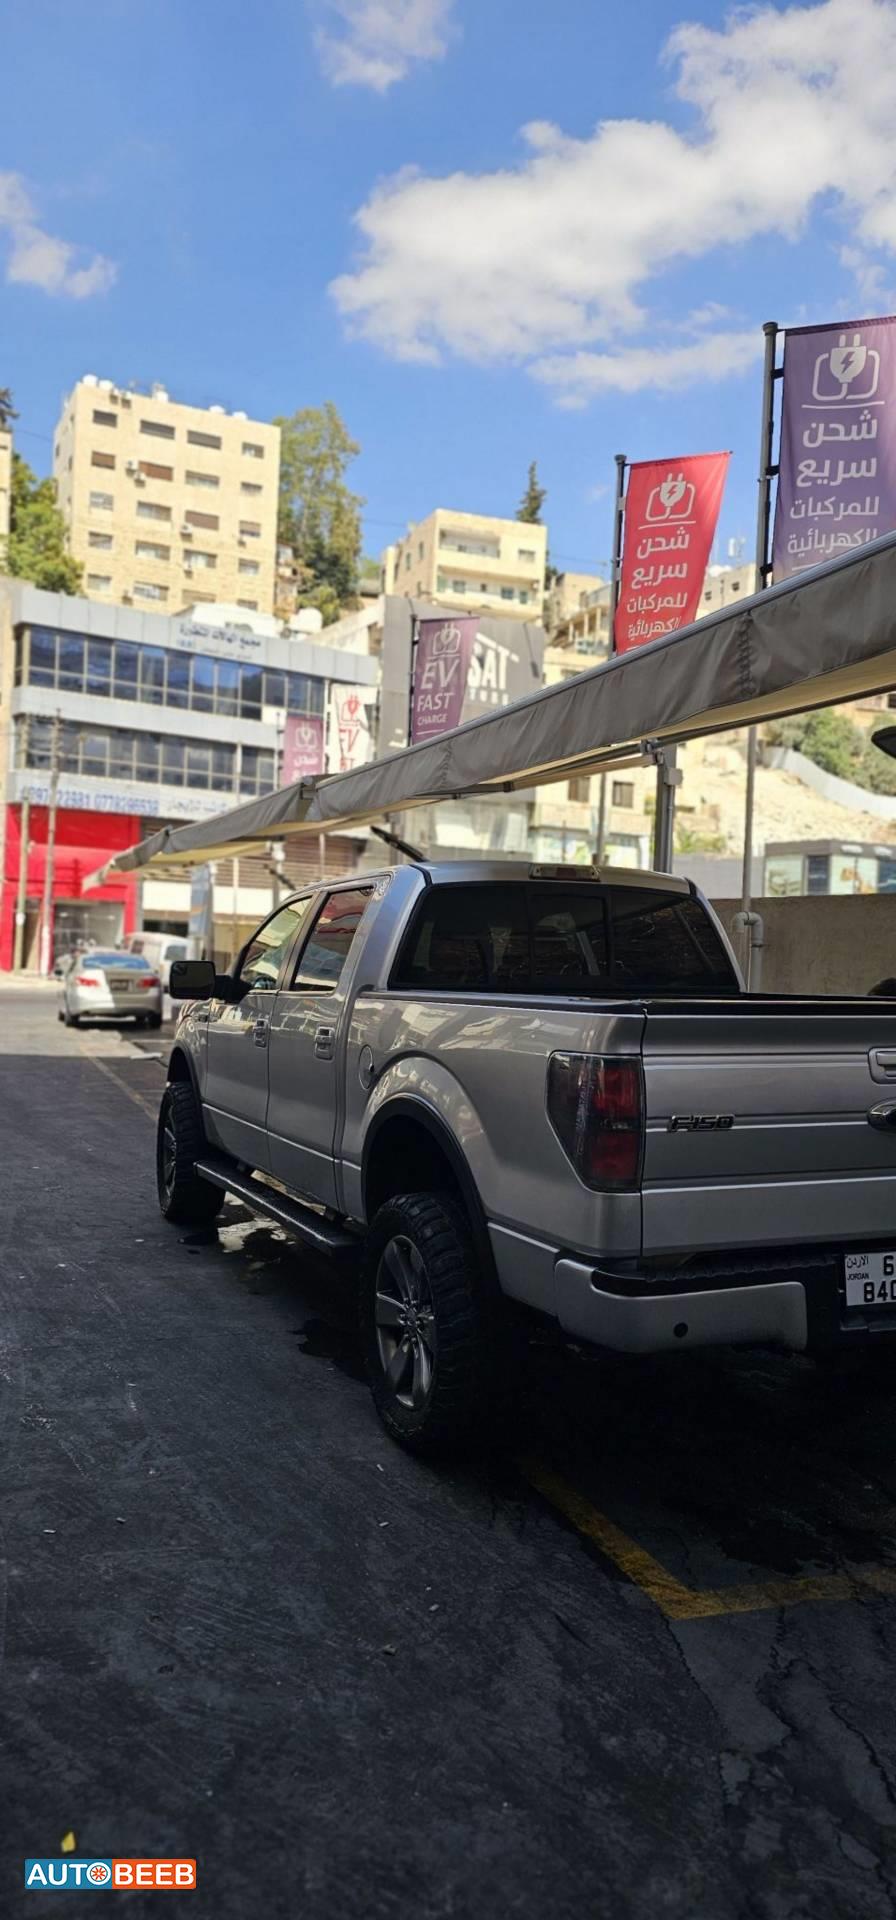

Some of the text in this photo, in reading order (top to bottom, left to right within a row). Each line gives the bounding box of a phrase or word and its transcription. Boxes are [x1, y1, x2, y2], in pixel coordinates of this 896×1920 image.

[803, 409, 877, 447] شحن
[796, 457, 877, 487] سريع
[790, 496, 879, 521] للمركبات
[637, 526, 690, 559] شحن
[631, 562, 688, 589] سريع
[627, 592, 688, 614] للمركبات
[421, 659, 460, 689] EV
[417, 692, 455, 712] FAST
